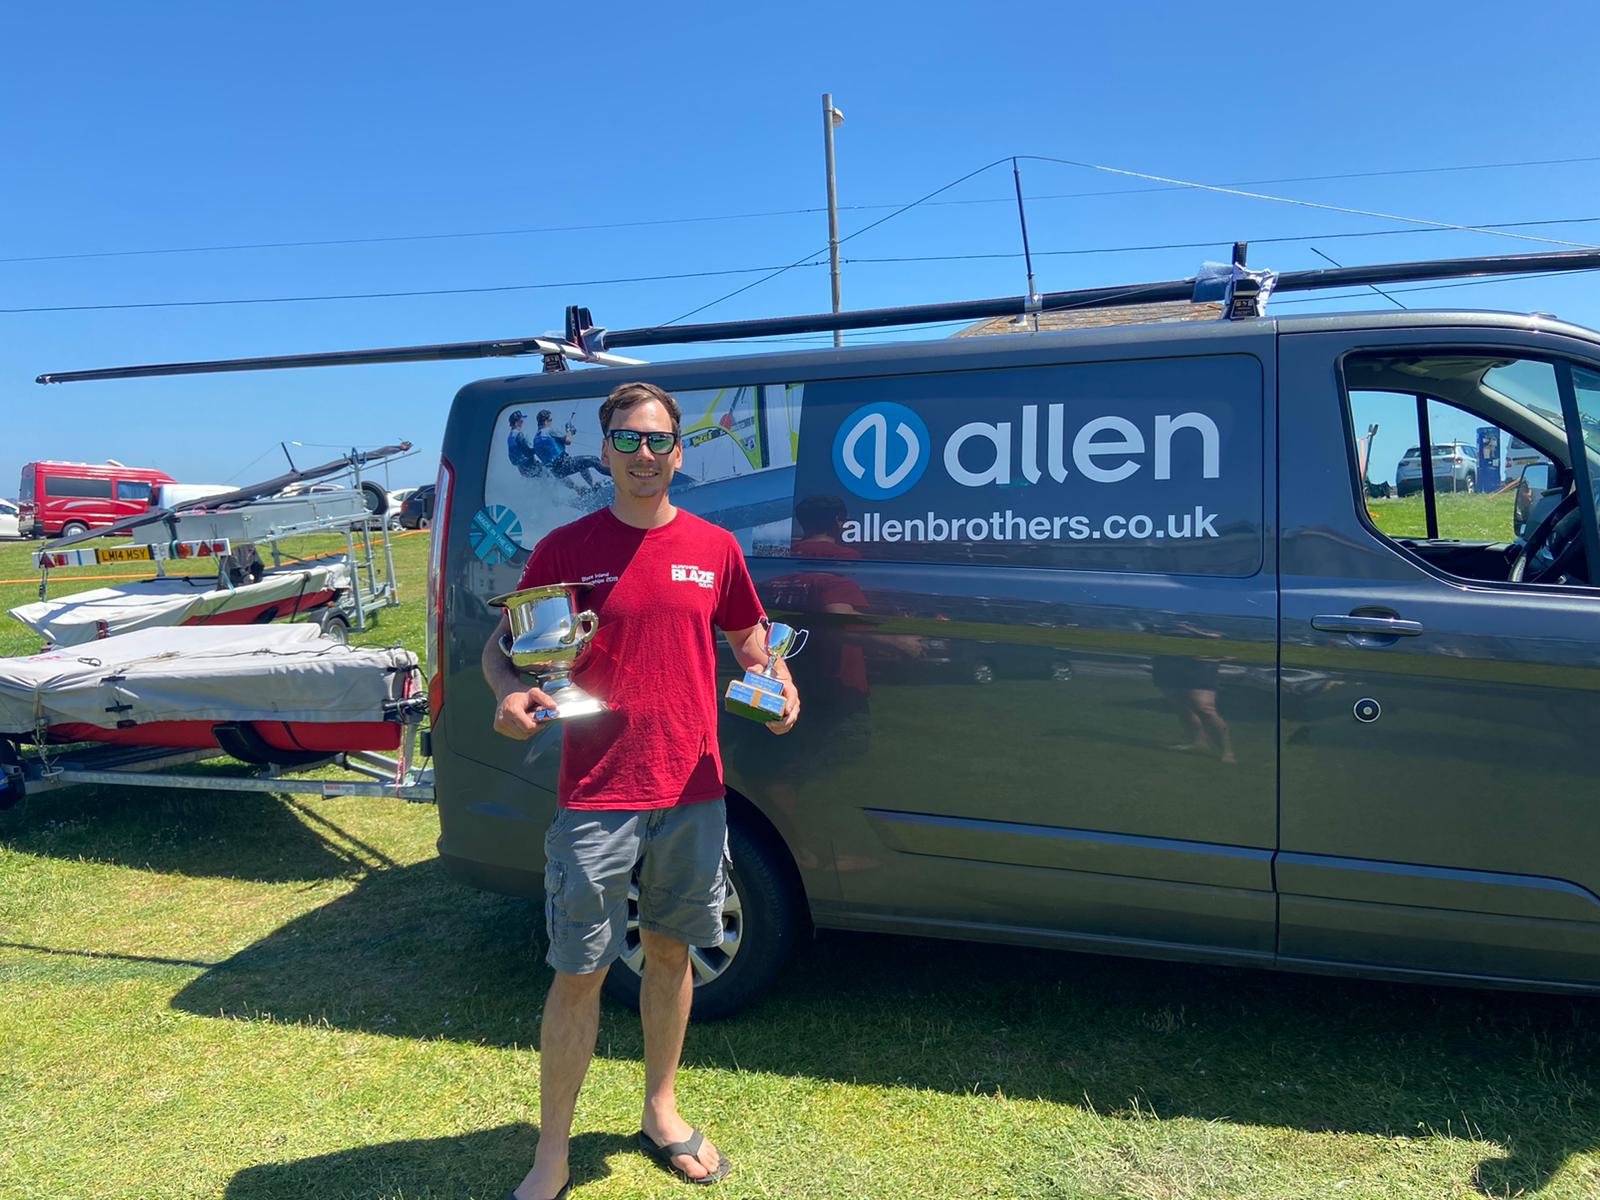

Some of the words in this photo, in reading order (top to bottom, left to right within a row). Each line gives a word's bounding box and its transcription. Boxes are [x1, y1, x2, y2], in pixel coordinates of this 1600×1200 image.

[943, 403, 1220, 487] allen
[841, 506, 1220, 543] allenbrothers.co.uk
[126, 548, 146, 560] MSY
[671, 568, 715, 583] BLAZE
